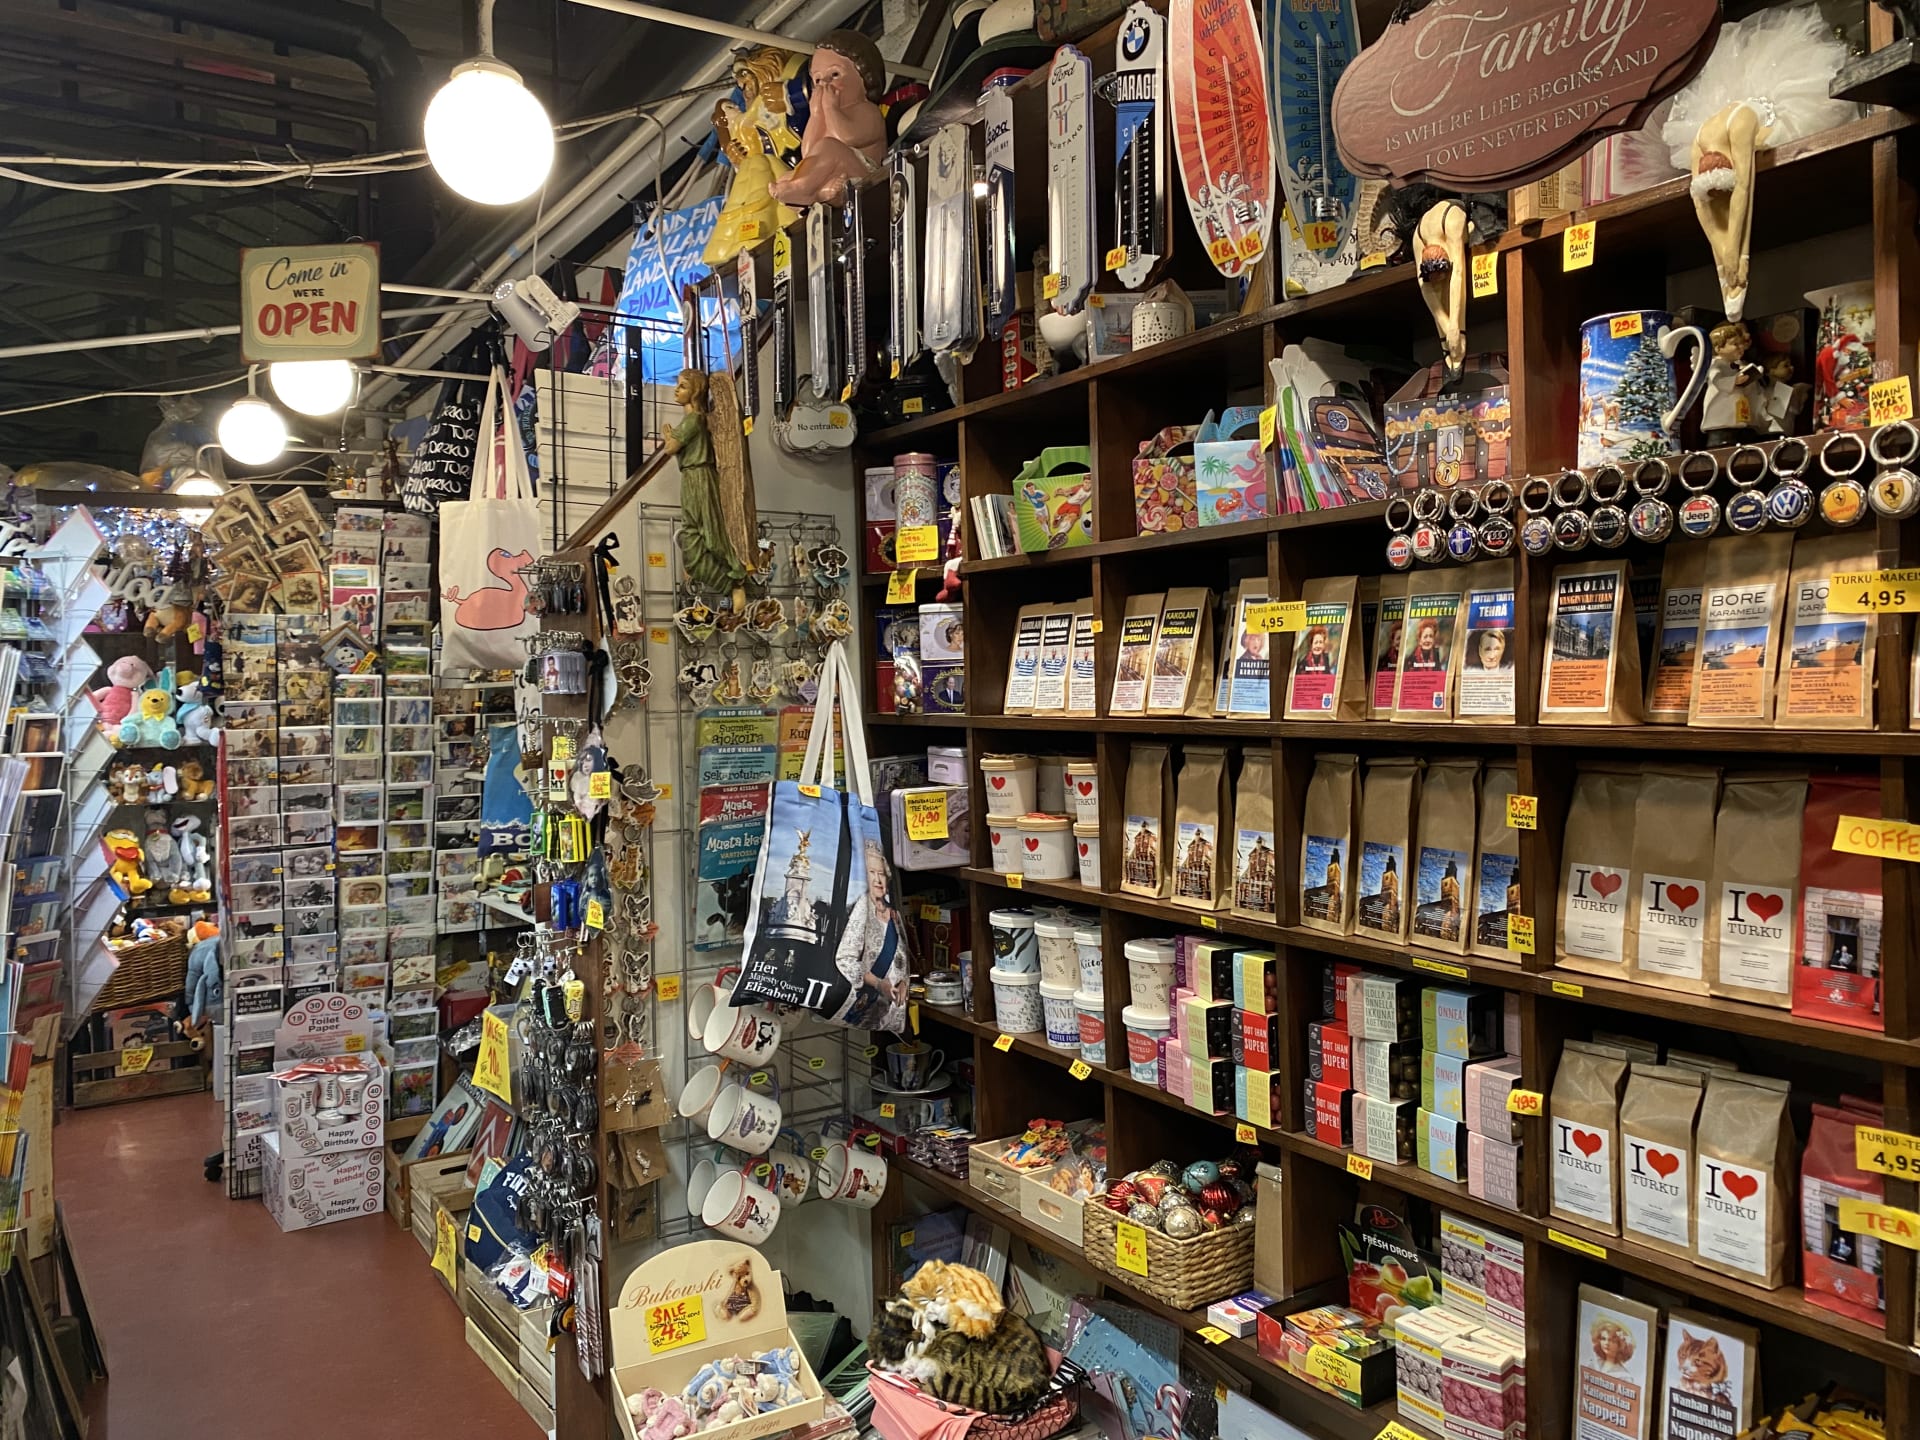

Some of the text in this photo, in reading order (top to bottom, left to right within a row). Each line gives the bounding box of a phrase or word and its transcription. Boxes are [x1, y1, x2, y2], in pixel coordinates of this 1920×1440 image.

[1298, 20, 1308, 30] C
[1329, 21, 1338, 30] F
[1208, 48, 1216, 57] C
[1390, 0, 1647, 116] Family
[1051, 61, 1076, 86] Ford
[1116, 73, 1157, 102] GARAGE
[1385, 45, 1659, 153] IS WHERE LIFE BEGINS AND
[1424, 94, 1610, 170] LOVE NEVER ENDS
[265, 256, 349, 290] Come in
[292, 287, 326, 299] WE'RE
[258, 299, 358, 338] OPEN
[1614, 319, 1638, 334] 29€
[1686, 510, 1709, 522] Jeep
[1389, 548, 1408, 558] Gulf
[1559, 578, 1616, 595] KAKOLAN
[1835, 574, 1873, 585] TURKU
[1711, 591, 1767, 607] BORE
[1857, 589, 1907, 610] 4,95
[1165, 610, 1196, 621] KAKOLAN
[1260, 616, 1284, 631] 4,95
[1160, 625, 1194, 636] SPESIAALI
[718, 724, 759, 733] Suomen-
[711, 731, 765, 747] ajokoira
[1572, 868, 1591, 899] I
[1647, 880, 1667, 912] I
[1571, 898, 1618, 915] TURKU
[1727, 889, 1746, 923] I
[1647, 910, 1699, 929] TURKU
[1726, 922, 1784, 941] TURKU
[752, 961, 778, 974] Her
[748, 972, 804, 994] Majesty Queen
[744, 980, 799, 1004] Elizabeth
[799, 977, 833, 1010] II
[309, 1002, 321, 1010] 30
[331, 999, 342, 1008] 40
[347, 1008, 358, 1016] 50
[309, 1016, 340, 1025] Toilet
[1437, 1005, 1466, 1022] ONNEA!
[308, 1023, 341, 1033] Paper
[1243, 1038, 1268, 1054] SUPER!
[1322, 1038, 1349, 1054] OOT IHAN
[1322, 1053, 1349, 1072] SUPER!
[1434, 1066, 1460, 1085] ONNEA!
[369, 1086, 380, 1095] 40
[367, 1103, 377, 1111] 30
[1316, 1096, 1327, 1109] OOT
[368, 1118, 378, 1127] 50
[1316, 1110, 1340, 1129] SUPER!
[327, 1128, 355, 1139] Happy
[1430, 1126, 1455, 1146] ONNEA!
[1557, 1123, 1573, 1156] I
[1859, 1130, 1899, 1147] TURKU
[323, 1137, 360, 1148] Birthday
[370, 1153, 381, 1162] 40
[1558, 1154, 1603, 1175] TURKU
[1630, 1142, 1646, 1176] I
[1873, 1151, 1920, 1175] 4,95
[336, 1163, 363, 1175] Happy
[369, 1184, 380, 1193] 50
[1630, 1174, 1680, 1198] TURKU
[1705, 1163, 1722, 1199] I
[326, 1204, 361, 1217] Birthday
[330, 1197, 357, 1207] Happy
[1705, 1197, 1757, 1222] TURKU
[1855, 1211, 1913, 1239] TEA
[1362, 1233, 1419, 1264] FRESH DROPS
[625, 1273, 724, 1310] Bukowski
[653, 1302, 687, 1324] SALE
[1616, 1381, 1637, 1400] Ajan
[1582, 1397, 1628, 1429] Nappeja
[1671, 1391, 1734, 1422] Wanhan Ajan
[1671, 1406, 1734, 1436] Tummasuklaa
